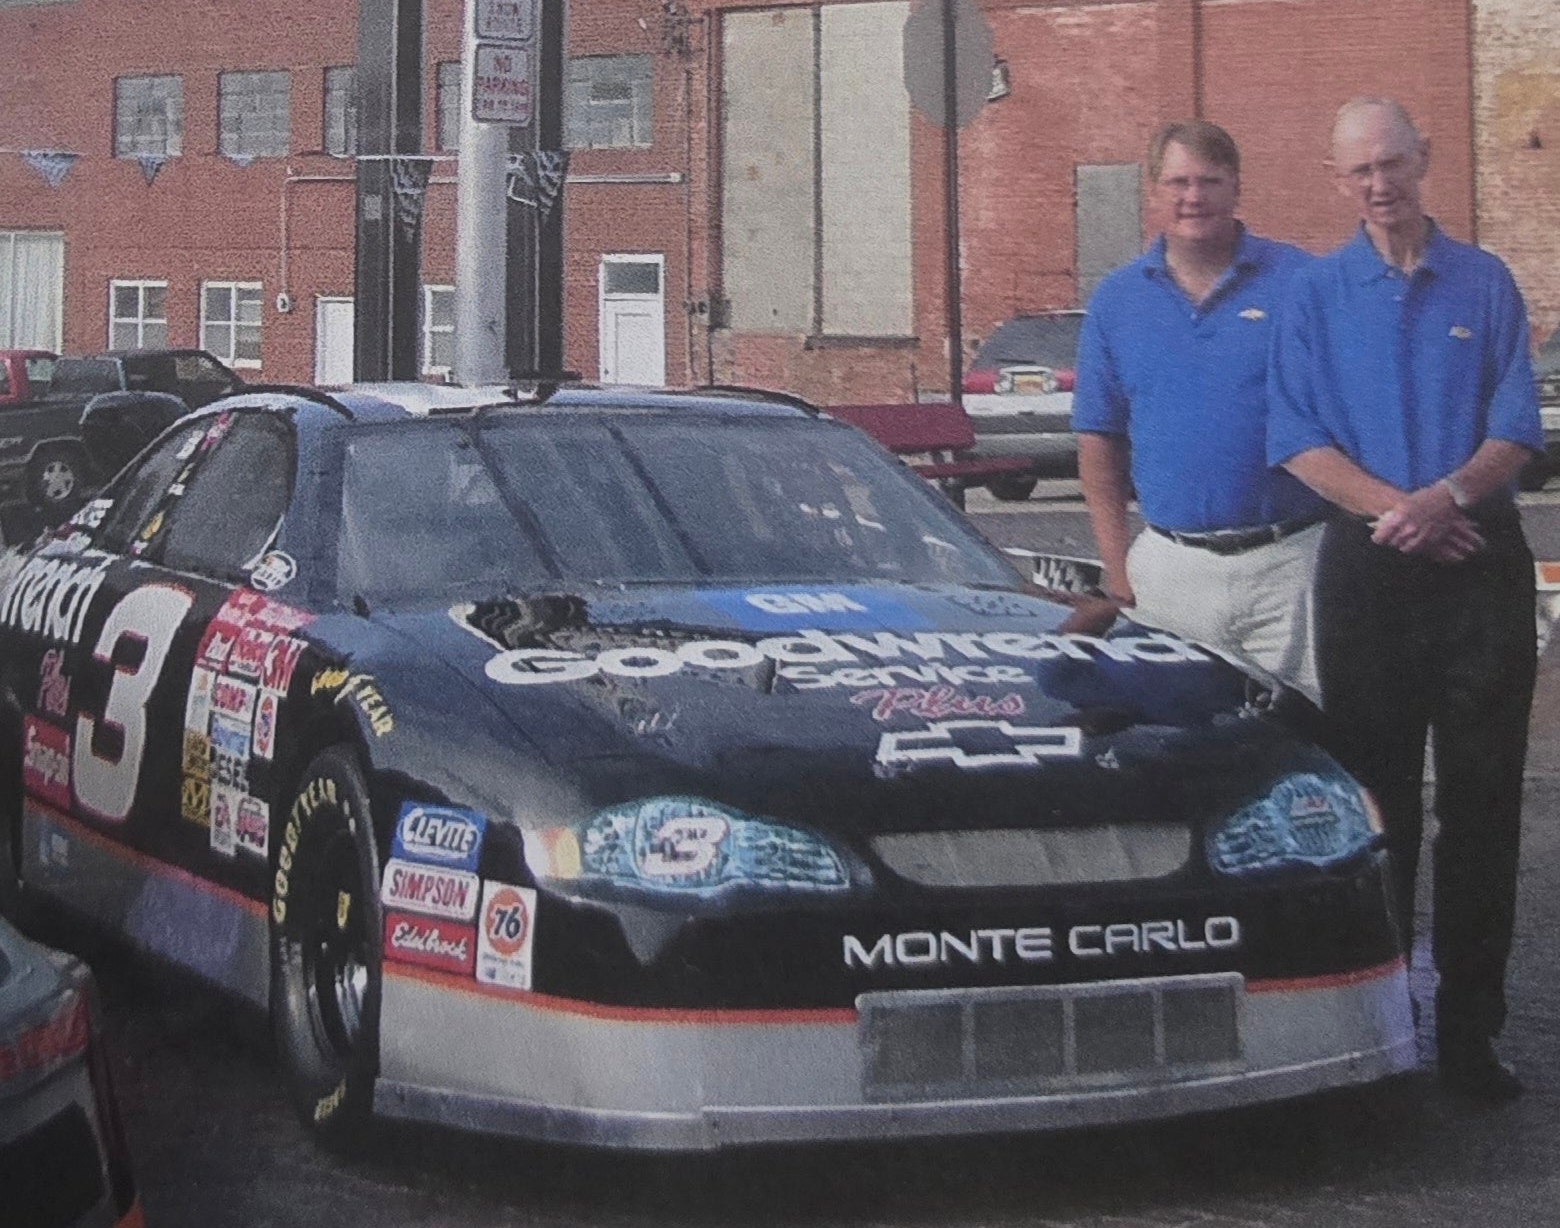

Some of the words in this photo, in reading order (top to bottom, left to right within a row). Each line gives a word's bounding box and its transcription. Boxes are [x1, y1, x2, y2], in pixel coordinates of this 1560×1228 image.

[493, 54, 512, 74] NO
[476, 76, 530, 97] PARKING
[744, 593, 868, 615] GM
[71, 582, 197, 822] 3
[389, 868, 470, 910] SIMPSON
[492, 905, 522, 940] 76
[842, 927, 1054, 967] MONTE
[1068, 916, 1241, 956] CARLO
